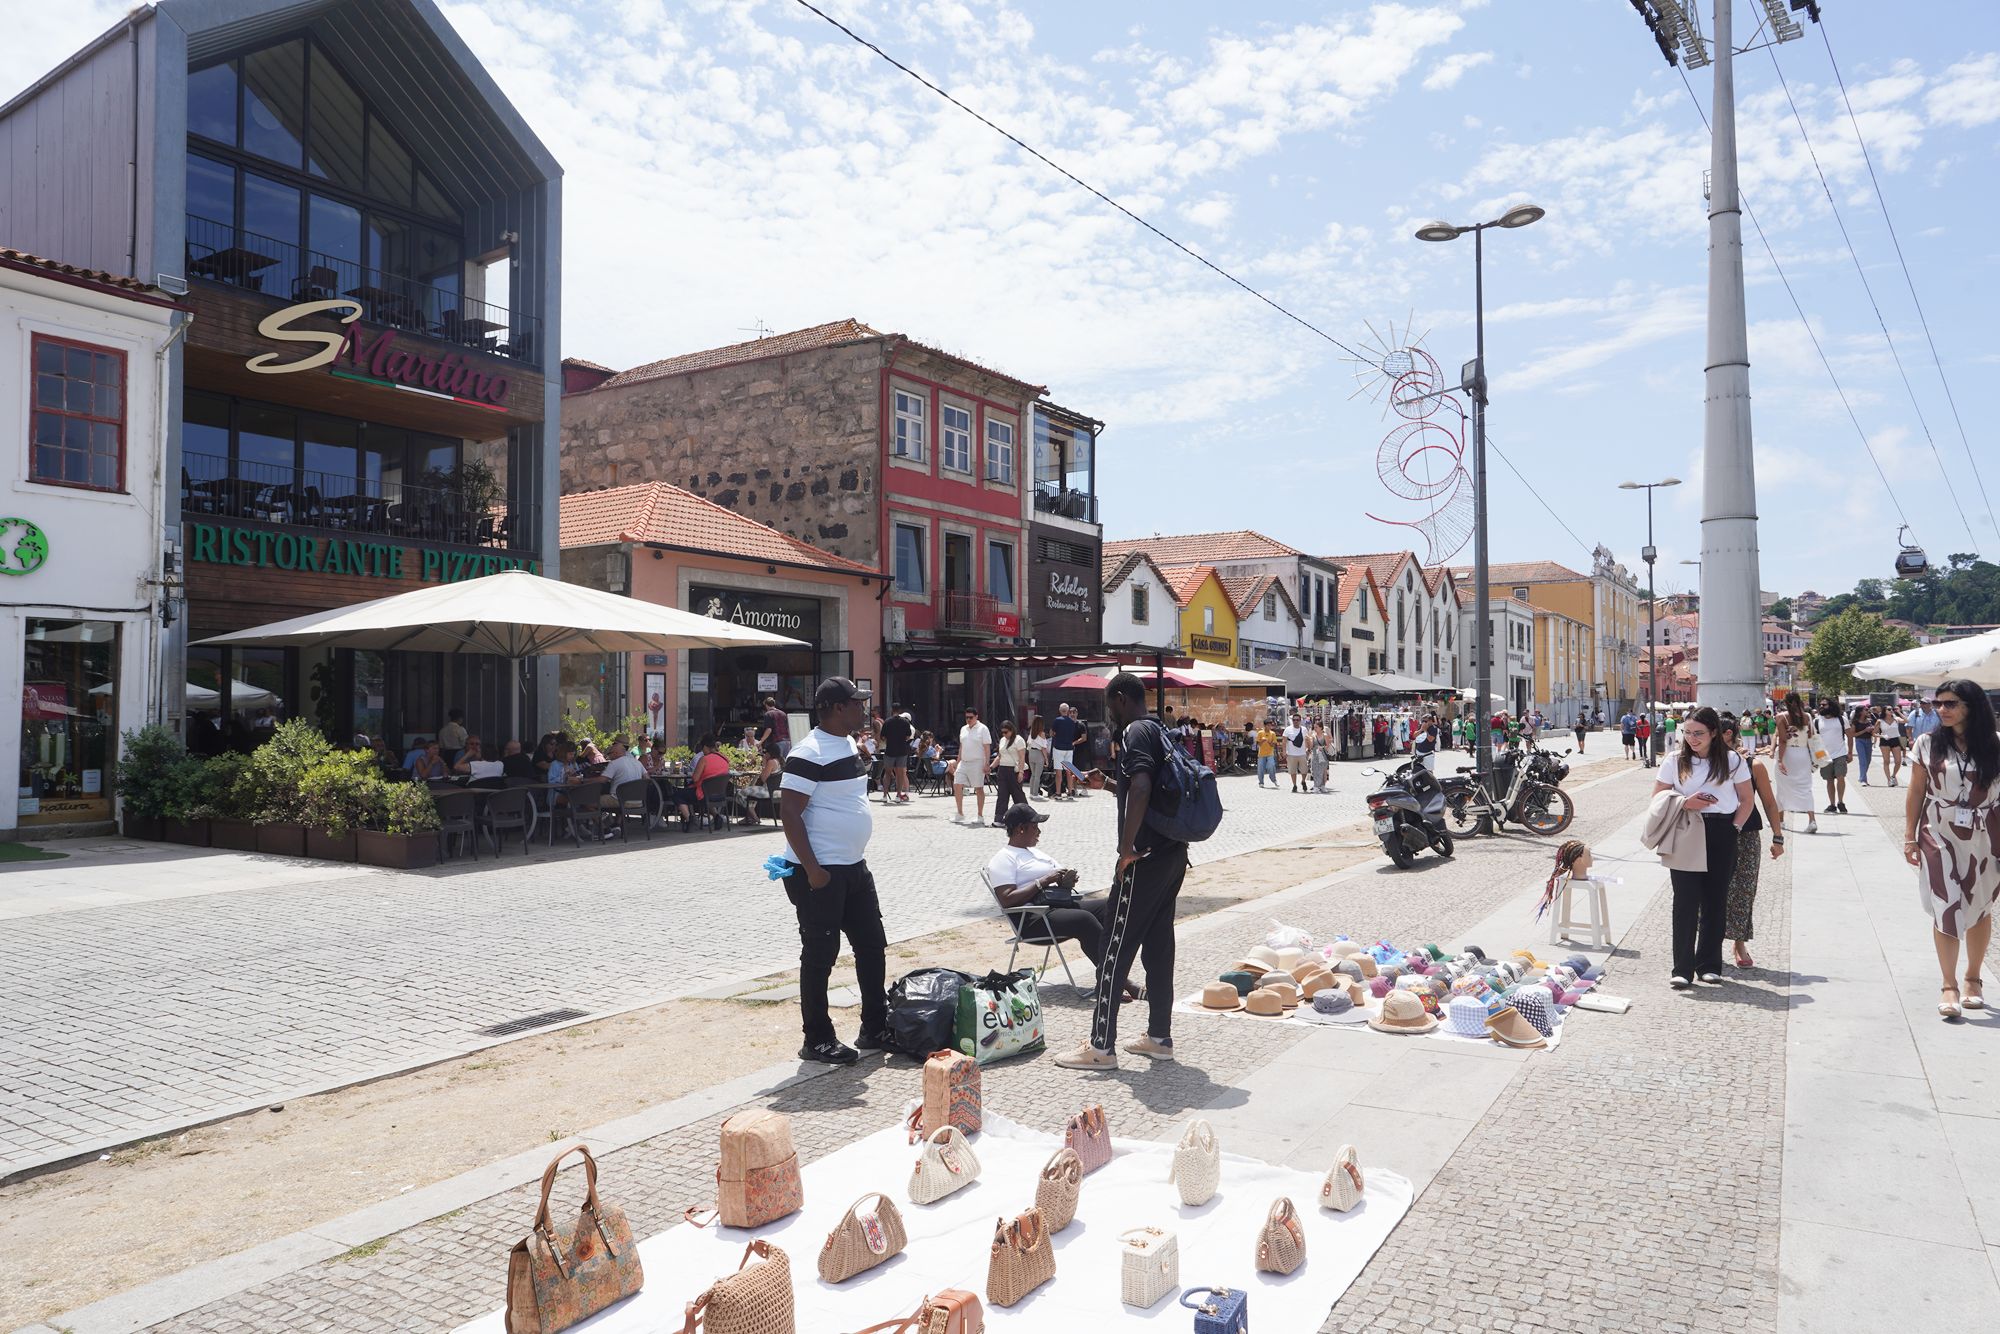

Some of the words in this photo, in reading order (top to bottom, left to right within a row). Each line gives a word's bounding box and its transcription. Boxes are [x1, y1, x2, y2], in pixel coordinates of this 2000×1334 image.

[332, 320, 510, 401] Martino
[193, 524, 406, 579] RISTORANTE
[1051, 572, 1088, 598] Rabelos
[729, 602, 800, 629] Amorino
[1081, 601, 1092, 613] Bar
[1193, 638, 1208, 650] CASA
[983, 1011, 1009, 1029] eu
